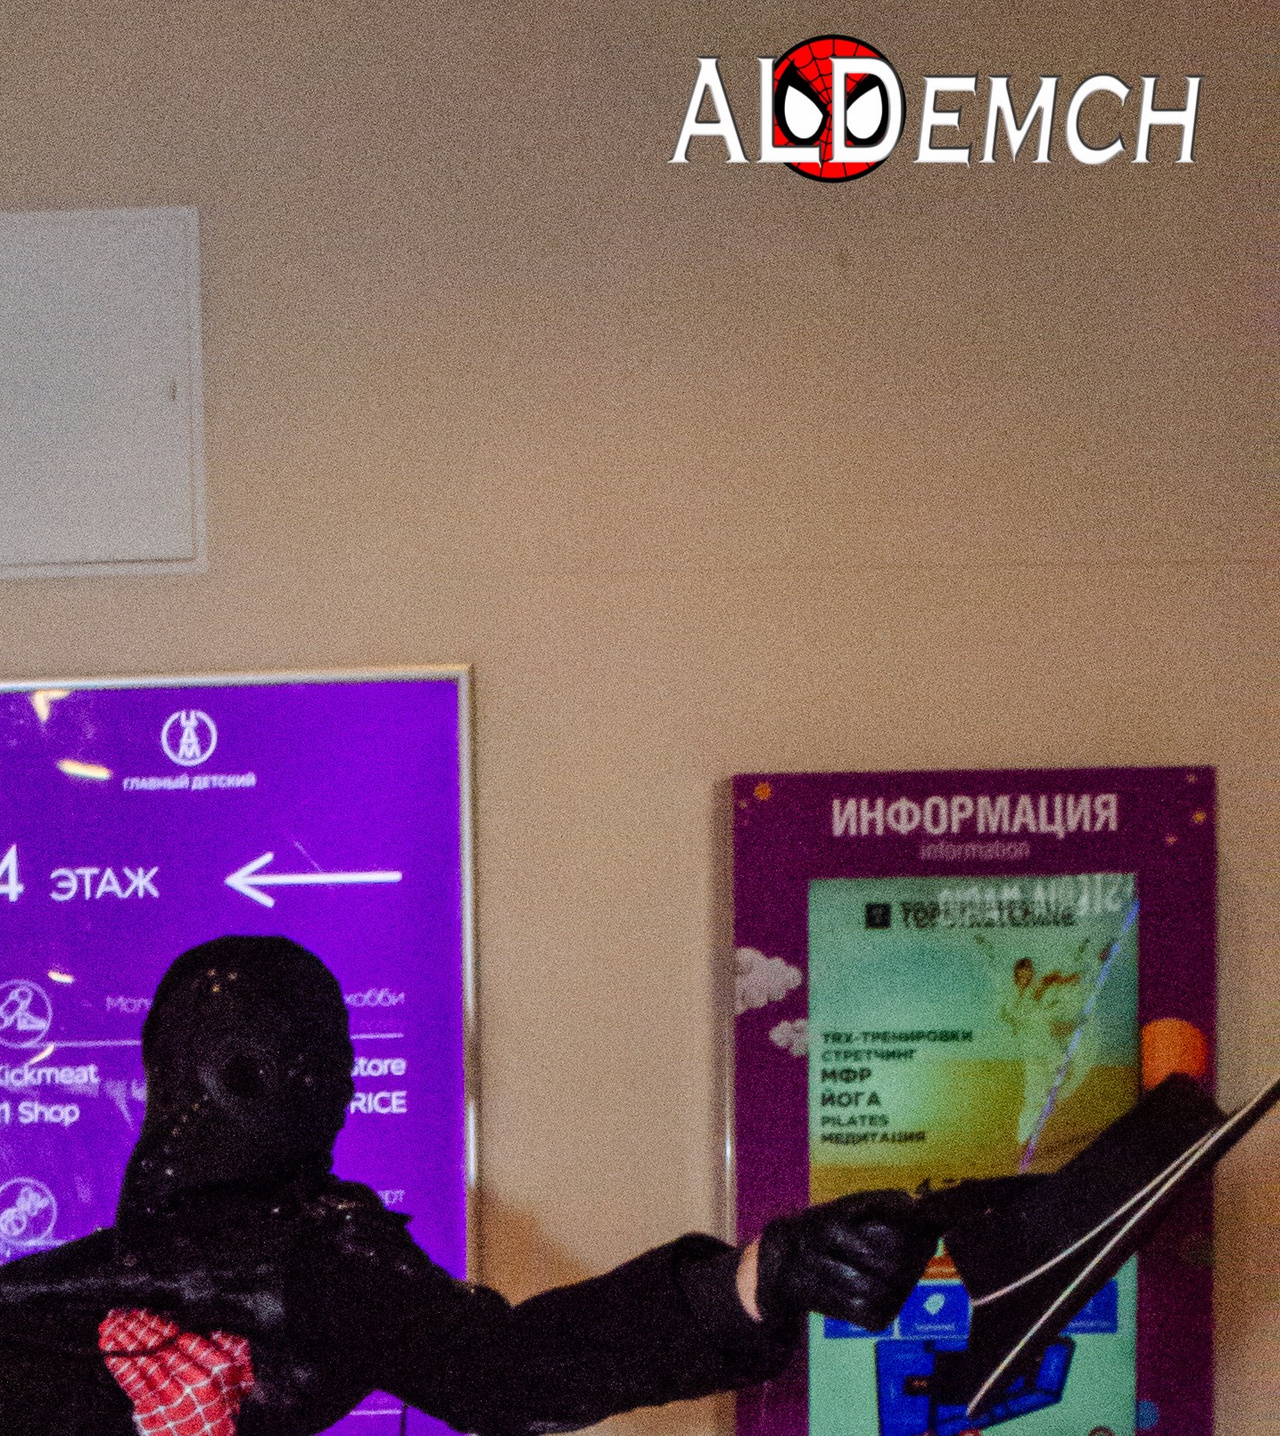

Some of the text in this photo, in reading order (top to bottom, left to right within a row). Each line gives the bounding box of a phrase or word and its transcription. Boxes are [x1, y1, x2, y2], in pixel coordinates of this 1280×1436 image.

[123, 771, 256, 791] ГЛАВНЫЙ ДЕТСКИЙ
[831, 793, 1119, 839] ИНФОРМАЦИЯ
[49, 865, 160, 901] ЭТАЖ
[820, 1067, 872, 1084] МФР
[820, 1088, 881, 1107] ЙОГА
[18, 1100, 81, 1127] Shop
[820, 1114, 889, 1126] PILATES
